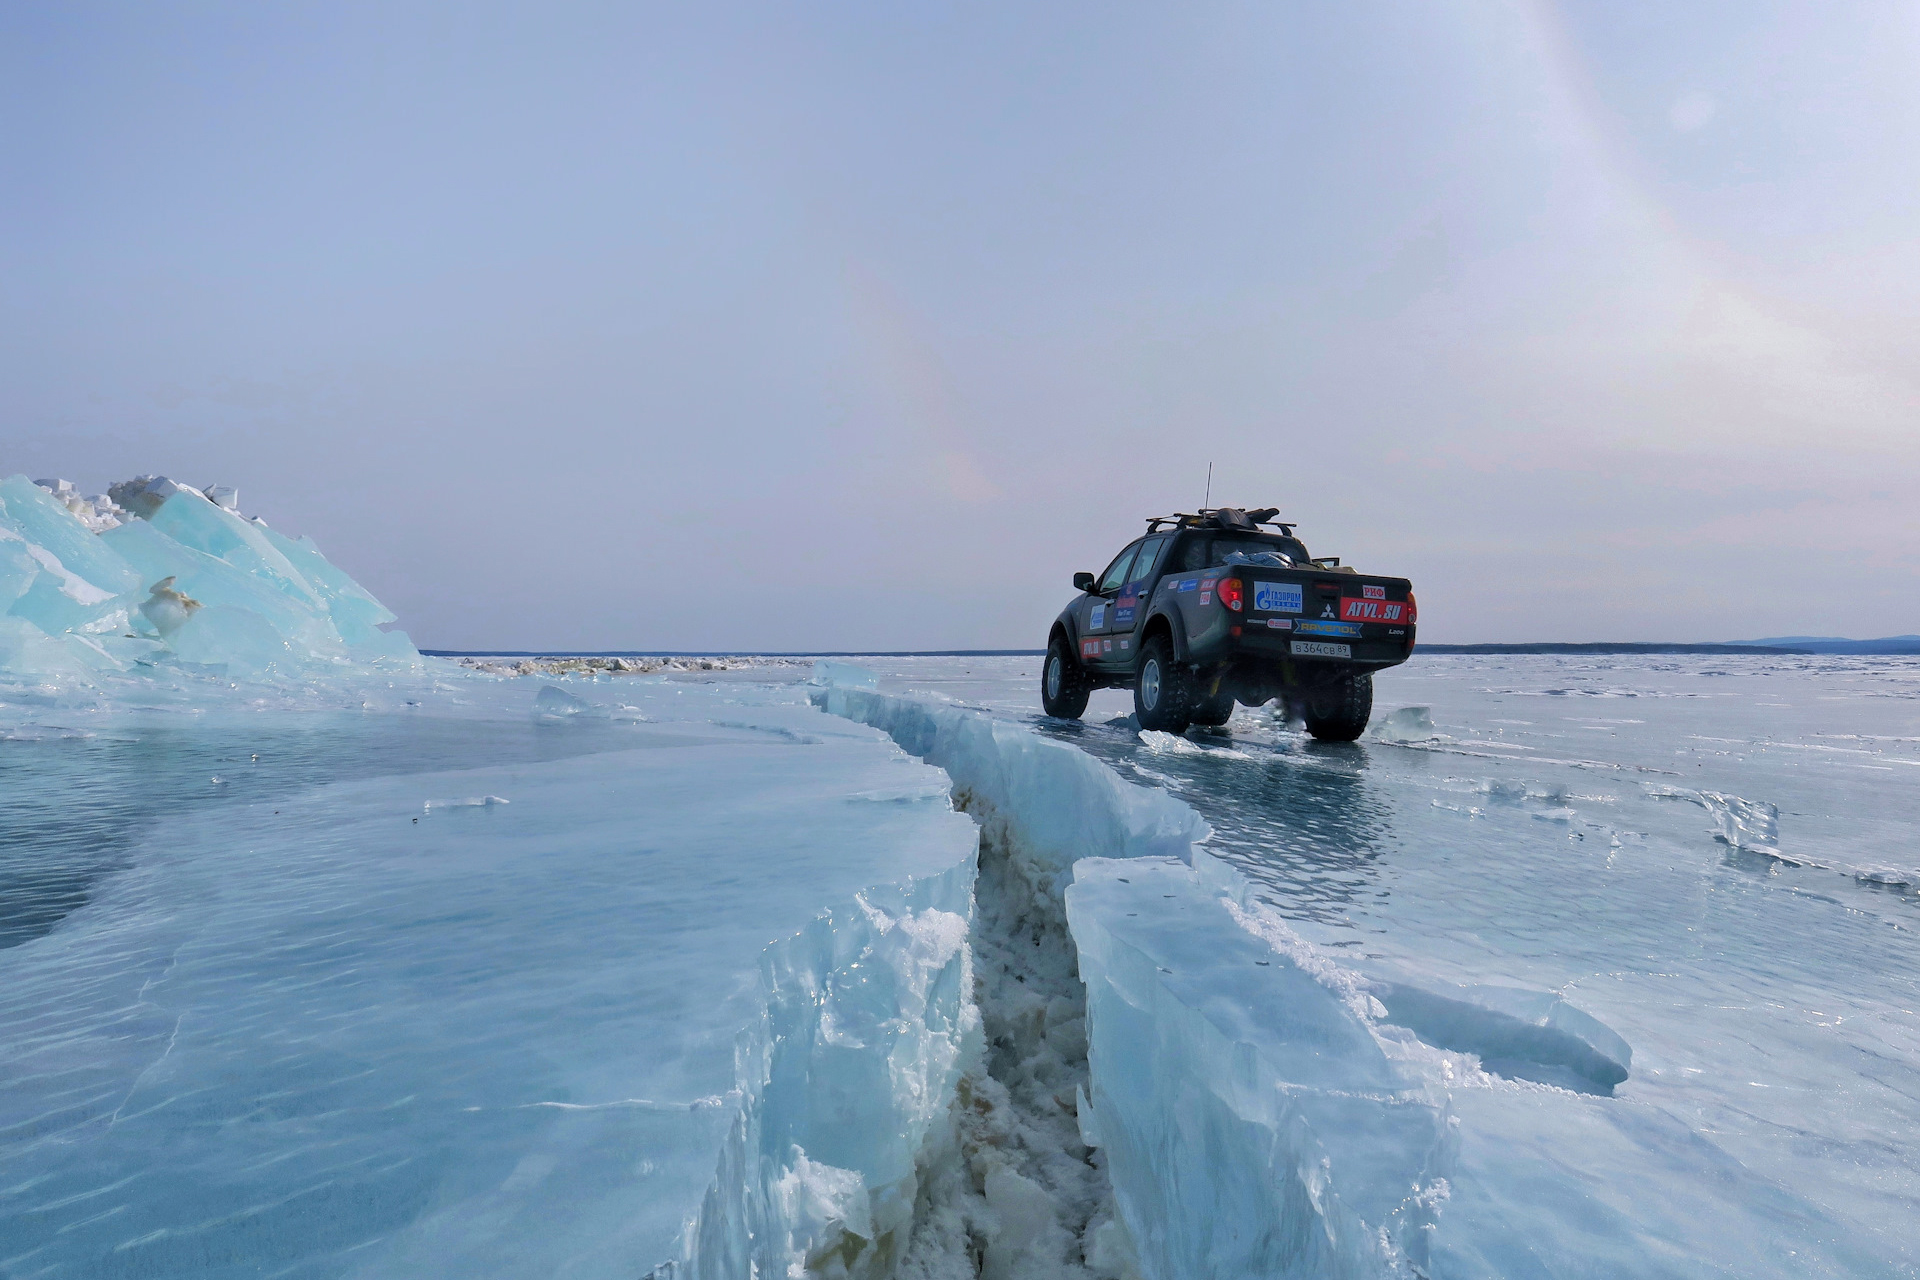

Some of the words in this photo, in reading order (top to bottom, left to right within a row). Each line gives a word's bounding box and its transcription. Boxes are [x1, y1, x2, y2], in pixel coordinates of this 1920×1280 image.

[1271, 590, 1301, 602] ГАЗПРОМ
[1346, 601, 1402, 620] ATVL.SU
[1300, 623, 1357, 635] RAVENOL
